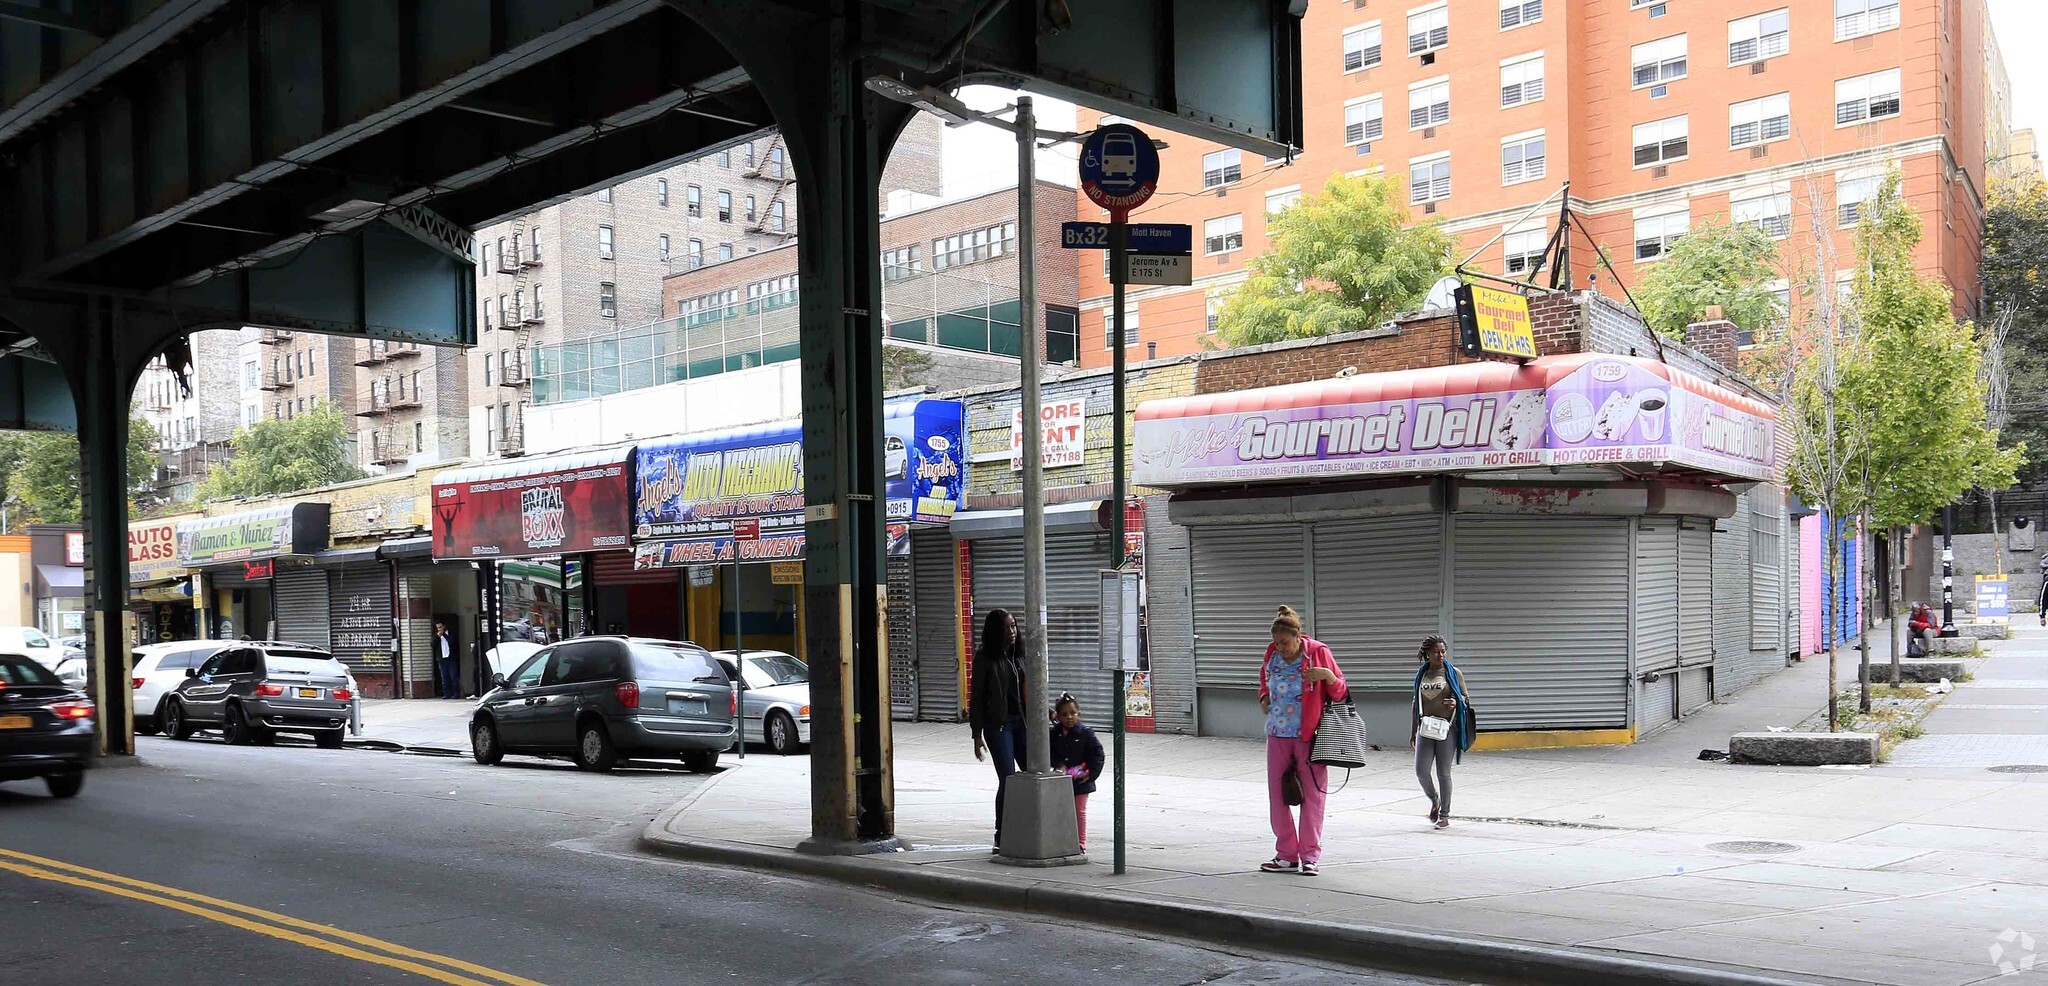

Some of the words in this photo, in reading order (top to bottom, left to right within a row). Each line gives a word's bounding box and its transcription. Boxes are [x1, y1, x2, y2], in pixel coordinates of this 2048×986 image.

[1089, 186, 1102, 199] NO
[1104, 186, 1150, 206] STANDING
[1066, 226, 1108, 245] Bx32
[1132, 228, 1148, 237] Mott
[1149, 228, 1172, 237] Haven
[1132, 257, 1159, 266] Jerome
[1161, 257, 1172, 266] Av
[1172, 258, 1178, 266] &
[1139, 269, 1153, 277] 175
[1154, 269, 1163, 277] St
[1482, 291, 1517, 305] Mike's
[1477, 302, 1526, 322] Gourmet
[1493, 318, 1515, 333] Deli
[1482, 329, 1504, 349] OPEN
[1504, 333, 1514, 351] 24
[1514, 334, 1534, 355] HRS.
[1597, 365, 1621, 377] 1759
[1166, 414, 1247, 468] Mike's
[1238, 404, 1406, 461] Gourmet
[1411, 398, 1497, 450] Deli
[1702, 403, 1745, 458] Gourmet
[1746, 416, 1765, 462] Deli
[931, 438, 946, 448] 1755
[1483, 453, 1508, 465] HOT
[1510, 451, 1541, 464] GRILL
[1553, 450, 1577, 462] HOT
[1580, 447, 1623, 461] COFFEE
[1625, 447, 1634, 459] &
[1637, 446, 1670, 459] GRILL
[683, 450, 722, 502] AUTO
[917, 453, 957, 483] Angel's
[1236, 469, 1253, 477] BEERS
[1259, 467, 1277, 475] SODAS
[1281, 465, 1300, 474] FRUITS
[1306, 462, 1341, 473] VEGETABLES
[1345, 462, 1365, 471] CANDY
[1369, 461, 1379, 470] ICE
[1380, 460, 1400, 469] CREAM
[1404, 459, 1416, 468] EBT
[1421, 458, 1432, 467] WIC
[1437, 457, 1450, 466] ATM
[1455, 456, 1476, 466] LOTTO
[637, 458, 681, 517] Angel's
[522, 487, 563, 512] BRUTAL
[695, 500, 736, 517] QUALITY
[737, 500, 747, 515] IS
[749, 497, 771, 514] OUR
[772, 494, 805, 512] STAND
[128, 526, 173, 545] AUTO
[190, 531, 228, 551] Ramon
[229, 532, 237, 544] &
[239, 521, 273, 544] Nuñez
[523, 511, 566, 541] BOXX
[639, 526, 651, 536] 1755
[128, 543, 173, 563] LASS
[670, 541, 716, 563] WHEEL
[717, 536, 805, 560] ALIGNMENT
